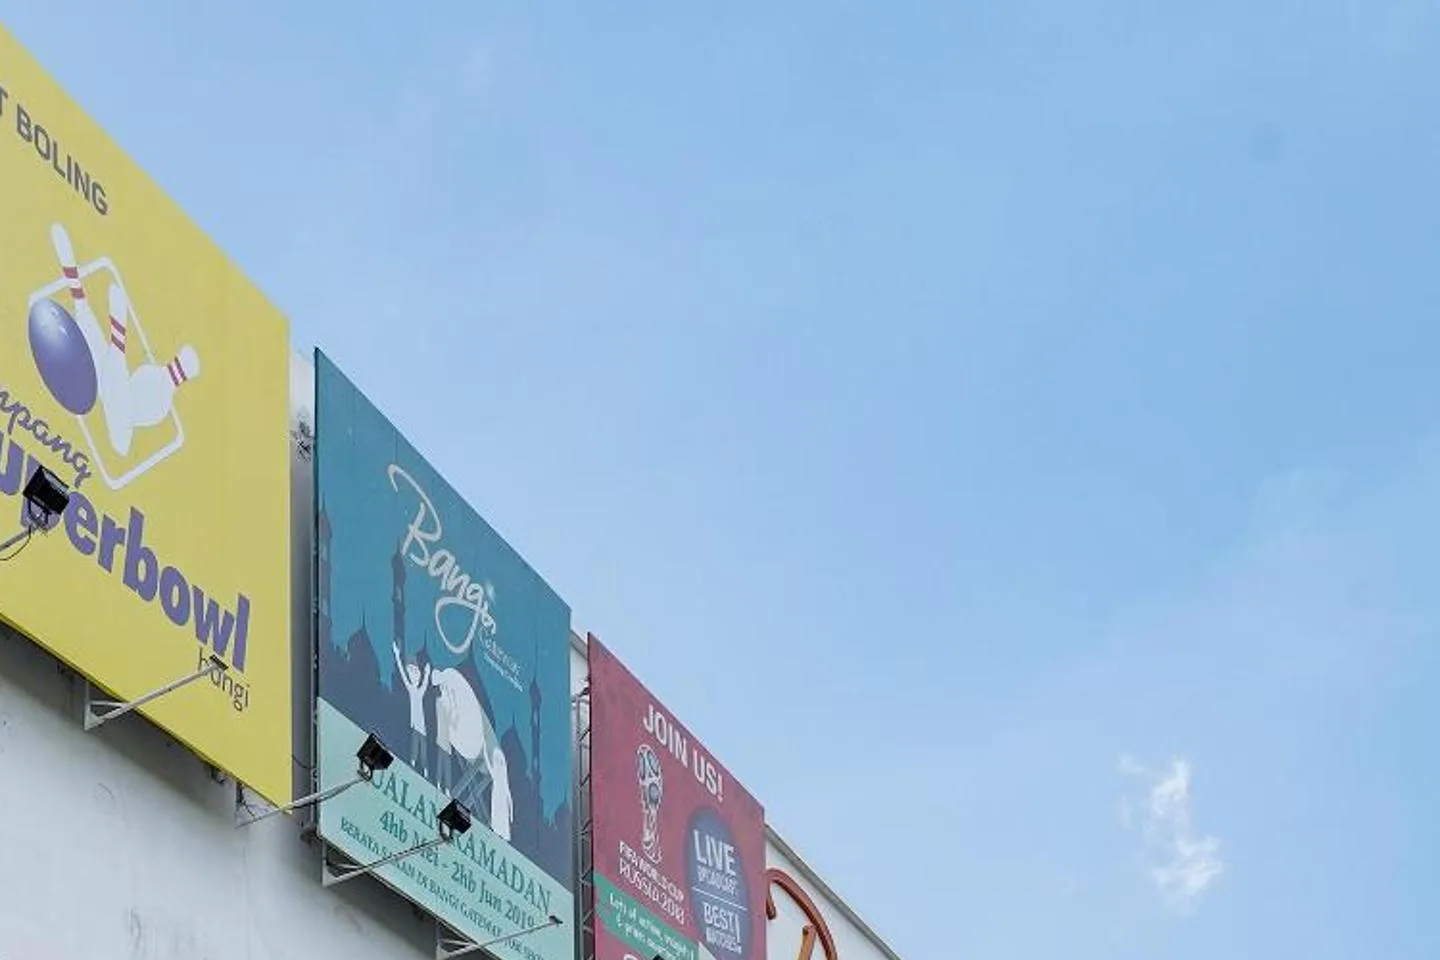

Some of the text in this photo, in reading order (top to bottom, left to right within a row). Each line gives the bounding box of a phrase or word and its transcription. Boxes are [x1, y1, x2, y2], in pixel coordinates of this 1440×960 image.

[16, 103, 109, 216] BOLING
[642, 703, 725, 802] JOIN US!
[693, 828, 736, 876] LIVE
